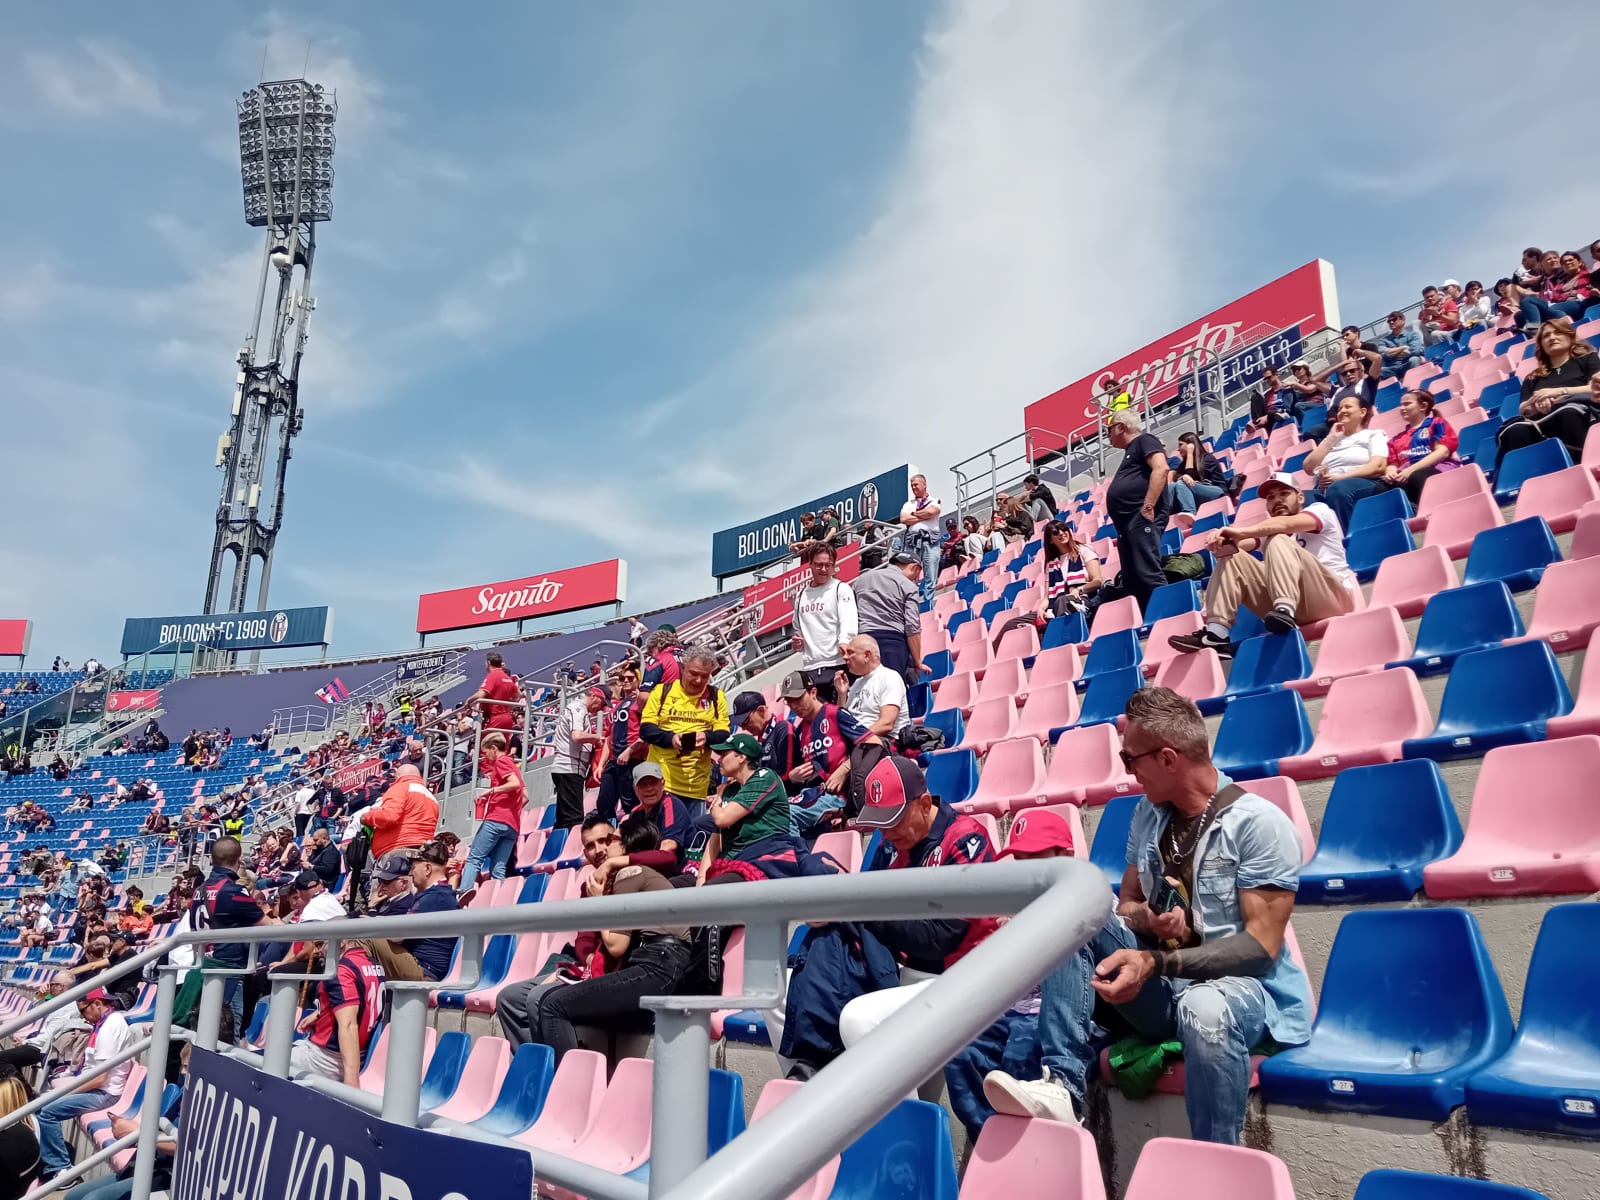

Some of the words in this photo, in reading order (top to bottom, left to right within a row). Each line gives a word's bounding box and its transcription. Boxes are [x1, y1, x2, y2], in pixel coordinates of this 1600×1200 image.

[1084, 319, 1243, 417] Saputo
[738, 517, 797, 559] BOLOGNA
[471, 577, 564, 619] Saputo
[159, 622, 216, 644] BOLOGNA
[236, 619, 268, 640] 1909
[802, 736, 833, 756] AZOO
[1574, 1101, 1586, 1111] 28
